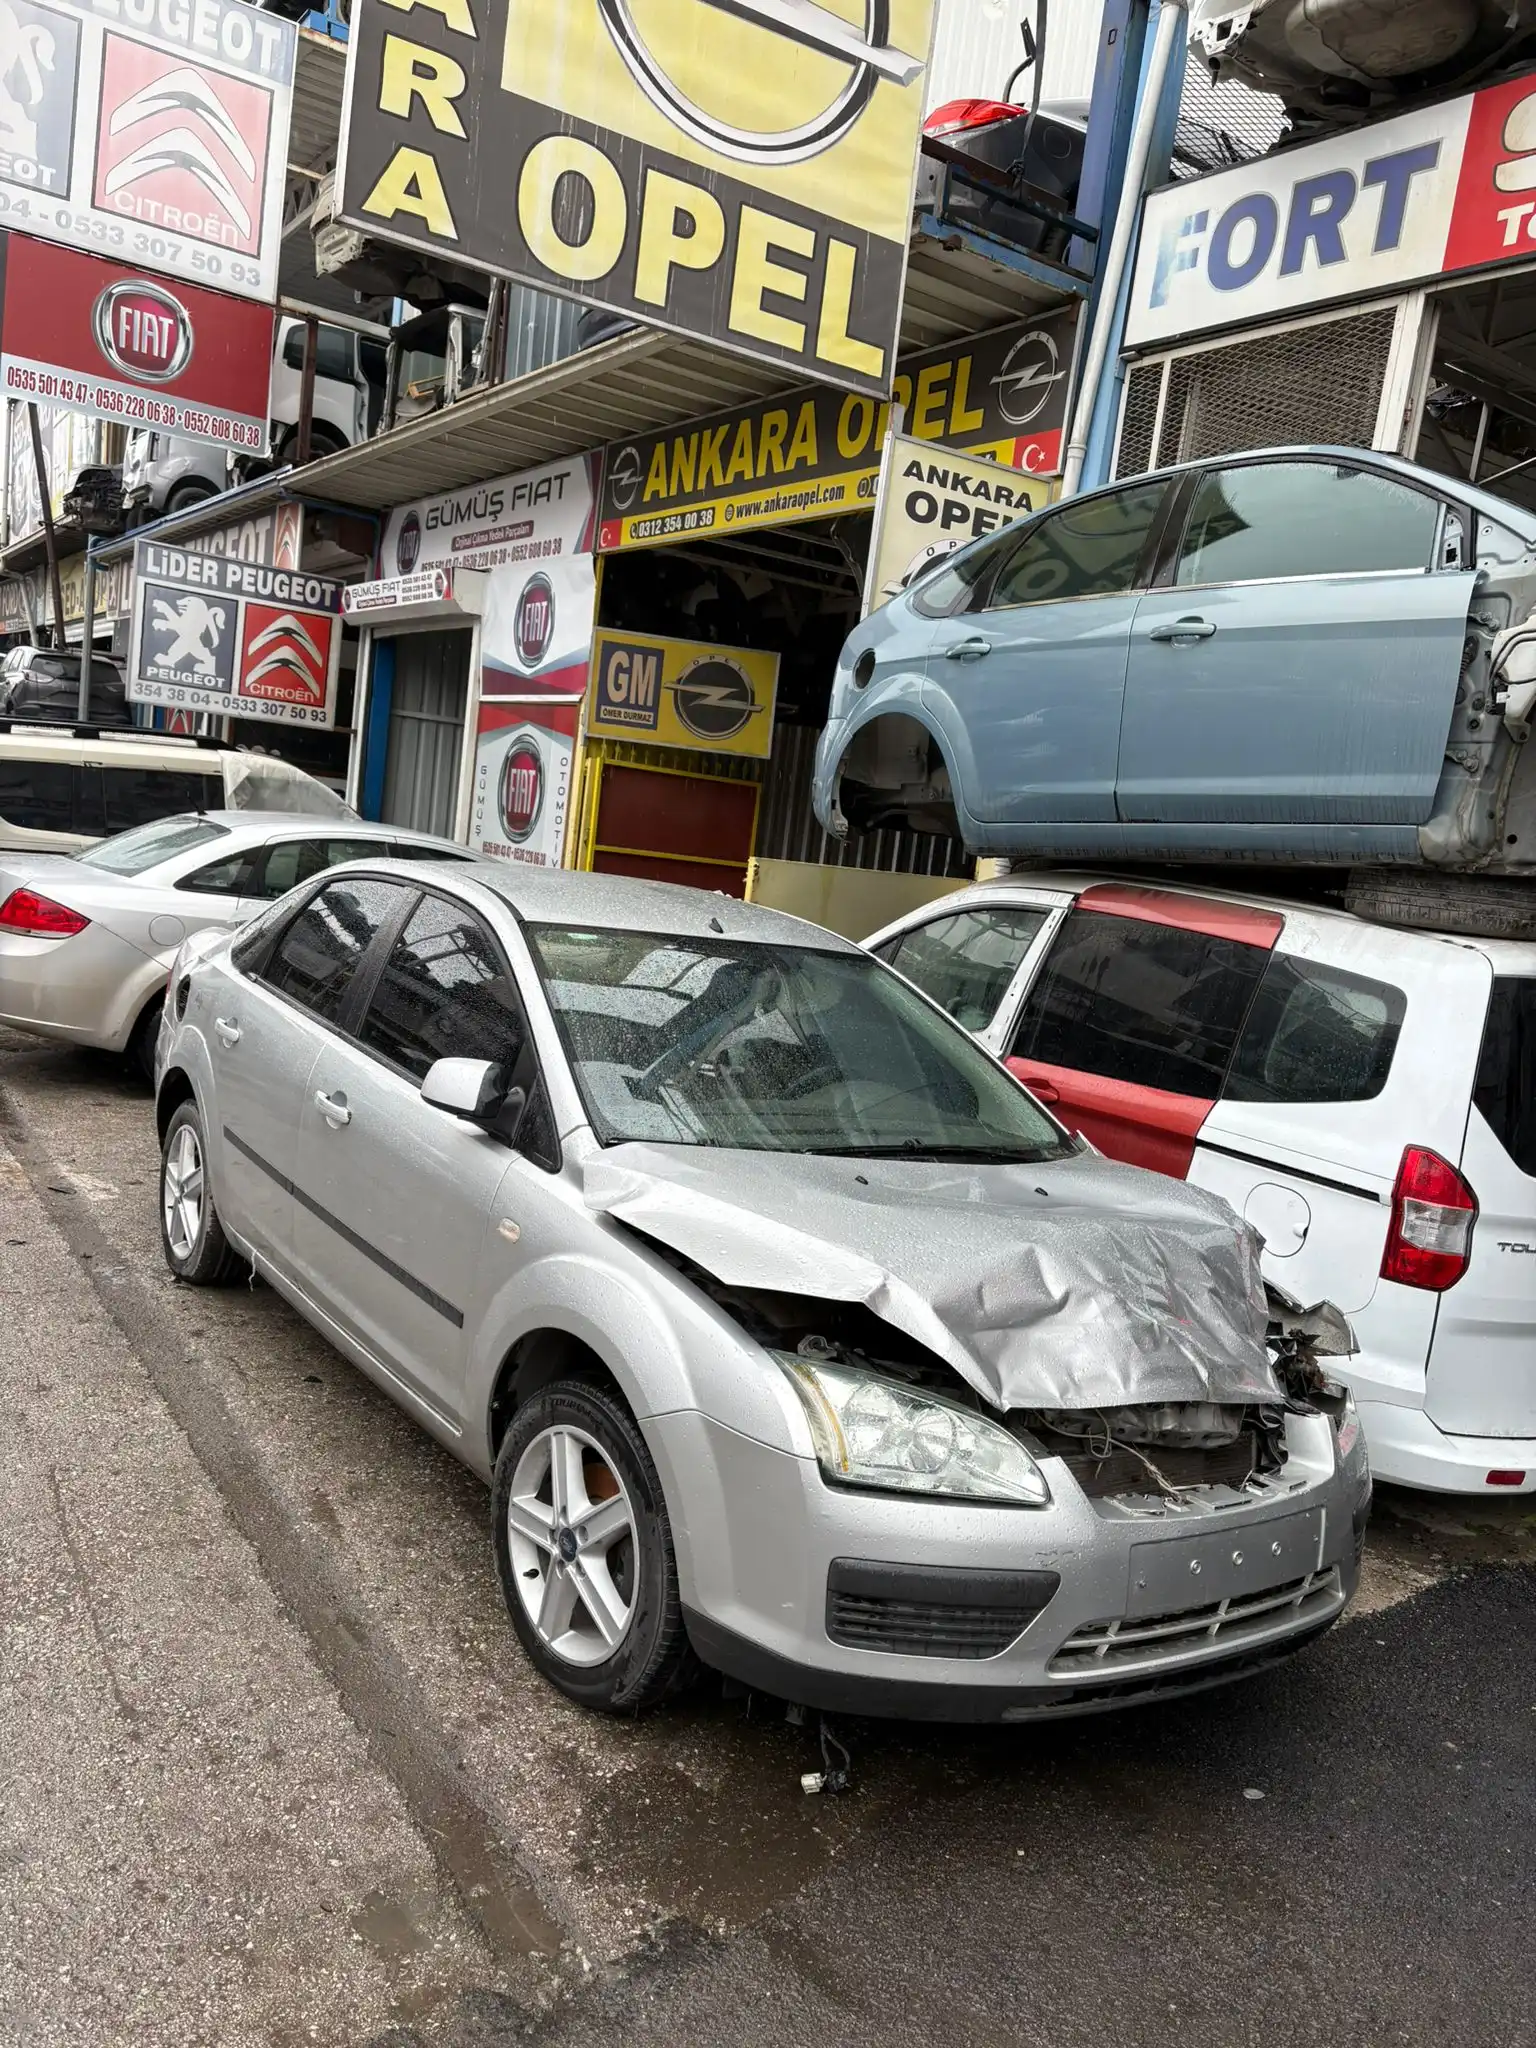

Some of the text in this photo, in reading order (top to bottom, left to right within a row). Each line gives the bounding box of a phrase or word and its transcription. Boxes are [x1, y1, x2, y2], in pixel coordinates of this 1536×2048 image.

[92, 0, 282, 75] GEOT
[55, 209, 125, 246] 0533
[133, 232, 183, 263] 307
[192, 252, 222, 275] 50
[230, 262, 261, 287] 93
[1149, 137, 1443, 309] FORT
[518, 135, 886, 378] OPEL
[119, 305, 174, 359] FIAT
[7, 366, 260, 447] 0535 501 43 47 0536 228 06 38 0552 608 60 38
[643, 400, 818, 503] ANKARA
[426, 472, 571, 531] GÜMÜŞ FIAT
[638, 484, 844, 538] 0312 354 00 38 www.ankaraopel.com
[903, 460, 1033, 513] ANKARA
[226, 564, 336, 607] PEUGEOT
[524, 600, 548, 642] FIAT
[134, 682, 163, 698] 354
[167, 689, 186, 702] 38
[190, 691, 210, 706] 04
[222, 695, 257, 713] 0533
[261, 702, 287, 717] 307
[290, 706, 307, 720] 50
[310, 709, 327, 723] 93
[146, 666, 226, 689] PEUGEOT
[606, 650, 657, 707] GM
[508, 768, 536, 815] FIAT
